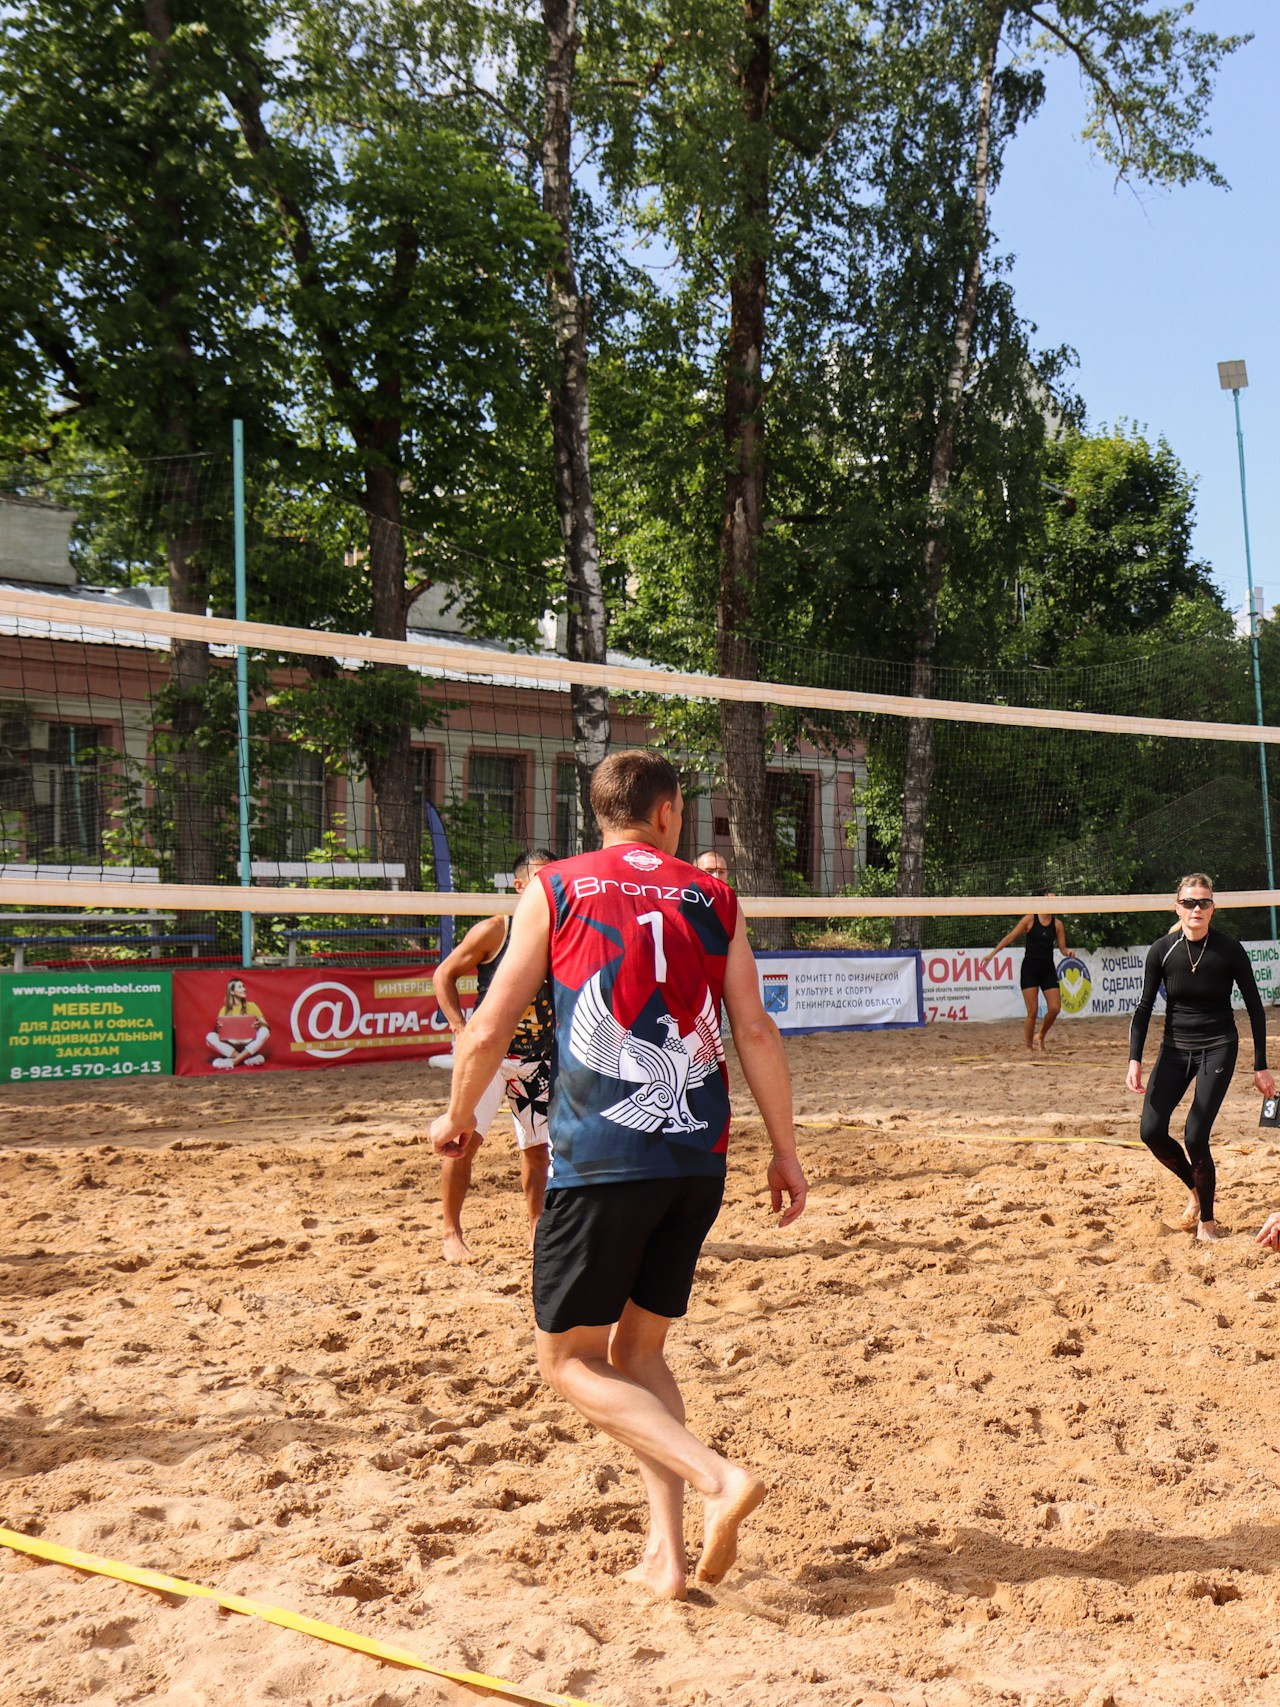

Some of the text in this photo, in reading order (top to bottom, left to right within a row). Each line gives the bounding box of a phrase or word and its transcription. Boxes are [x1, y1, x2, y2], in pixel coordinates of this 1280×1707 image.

[574, 876, 714, 908] Bronzov
[636, 910, 668, 983] 1
[1246, 948, 1279, 962] ЕЛИСЬ
[922, 951, 1013, 983] ОЙКИ
[1101, 955, 1143, 972] ХОЧЕШЬ
[795, 971, 899, 983] КОМИТЕТ ПО ФИЗИЧЕСКОЙ
[1254, 966, 1272, 982] ОЕЙ
[12, 983, 161, 996] www.proekt-mebel.com
[377, 979, 434, 994] ИНТЕРНЕ
[795, 986, 873, 996] КУЛЬТУРЕ И СПОРТУ
[52, 1002, 124, 1016] МЕБЕЛЬ
[795, 998, 902, 1010] ЛЕНИНГРАДСКОЙ ОБЛАСТИ
[1092, 997, 1140, 1013] МИР ЛУЧ
[18, 1018, 155, 1033] ДЛЯ ДОМА И ОФИСА
[9, 1031, 163, 1046] ПО ИНДИВИДУАЛЬНЫМ
[56, 1046, 120, 1058] ЗАКАЗАМ
[10, 1061, 161, 1079] 8-921-570-10-13
[1264, 1100, 1276, 1118] 3
